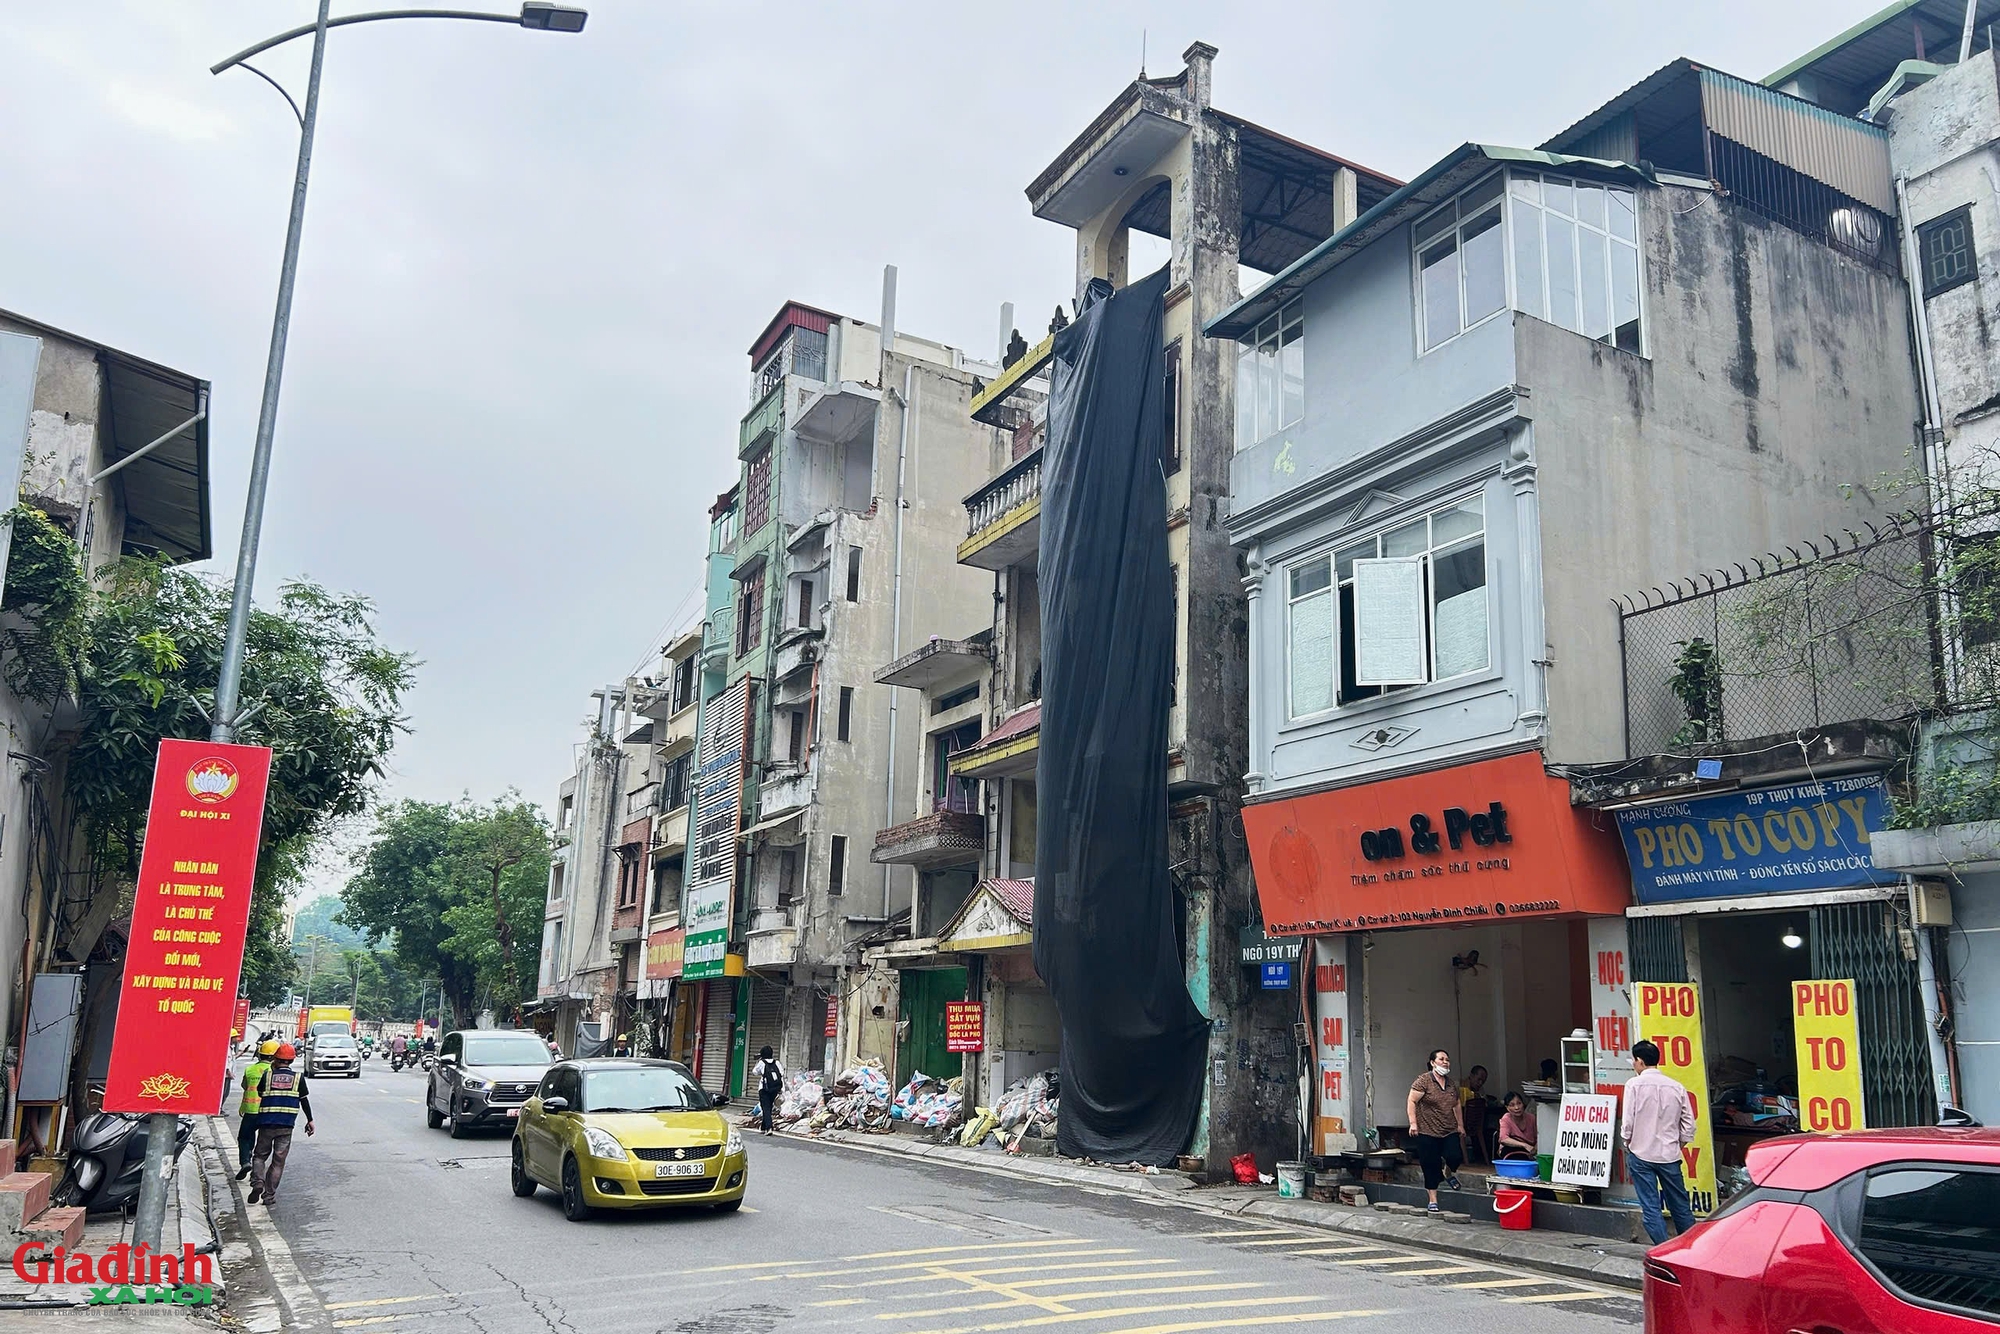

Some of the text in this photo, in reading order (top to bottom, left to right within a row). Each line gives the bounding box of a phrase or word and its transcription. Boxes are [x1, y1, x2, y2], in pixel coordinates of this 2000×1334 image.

[1746, 793, 1764, 805] 19P
[1767, 788, 1794, 803] THỤY
[180, 810, 230, 820] ĐẠI HỘI XI
[1620, 809, 1650, 824] MẠNH
[1360, 801, 1512, 862] on & Pet
[174, 860, 219, 874] NHÂN DÂN
[1655, 871, 1681, 887] ĐÁNH
[1682, 869, 1703, 884] MÁY
[1714, 866, 1738, 881] TÍNH
[1750, 863, 1781, 879] ĐÓNG
[1781, 860, 1801, 876] XÉN
[1802, 856, 1816, 874] SỔ
[1816, 856, 1845, 873] SÁCH
[1846, 852, 1869, 869] CÁC
[160, 881, 226, 900] LÀ TRUNG TÂM,
[164, 904, 176, 918] LÀ
[178, 906, 196, 920] CHỦ
[1398, 912, 1410, 922] 103
[153, 926, 222, 946] CỦA CÔNG CUỘC
[164, 950, 202, 968] ĐỔI MỚI,
[1242, 944, 1262, 960] NGÕ
[1266, 945, 1284, 959] 19Y
[1316, 958, 1345, 992] KHÁCH
[1598, 950, 1624, 992] HỌC
[132, 975, 224, 992] XÂY DỰNG VÀ BẢO VỆ
[158, 996, 195, 1014] TỔ QUỐC
[1642, 986, 1694, 1017] PHO
[1796, 982, 1849, 1016] PHO
[1323, 1017, 1343, 1050] SẠN
[1598, 1009, 1629, 1056] VIỆN
[1652, 1036, 1692, 1066] TO
[1806, 1037, 1846, 1071] TO
[1324, 1070, 1342, 1100] PET
[1564, 1101, 1609, 1124] BÚN CHẢ
[1809, 1096, 1852, 1131] CO
[1560, 1128, 1608, 1152] DỌC MÙNG
[1558, 1157, 1576, 1176] CHÂN
[1577, 1157, 1590, 1176] GIÒ
[1590, 1160, 1606, 1180] MỌC
